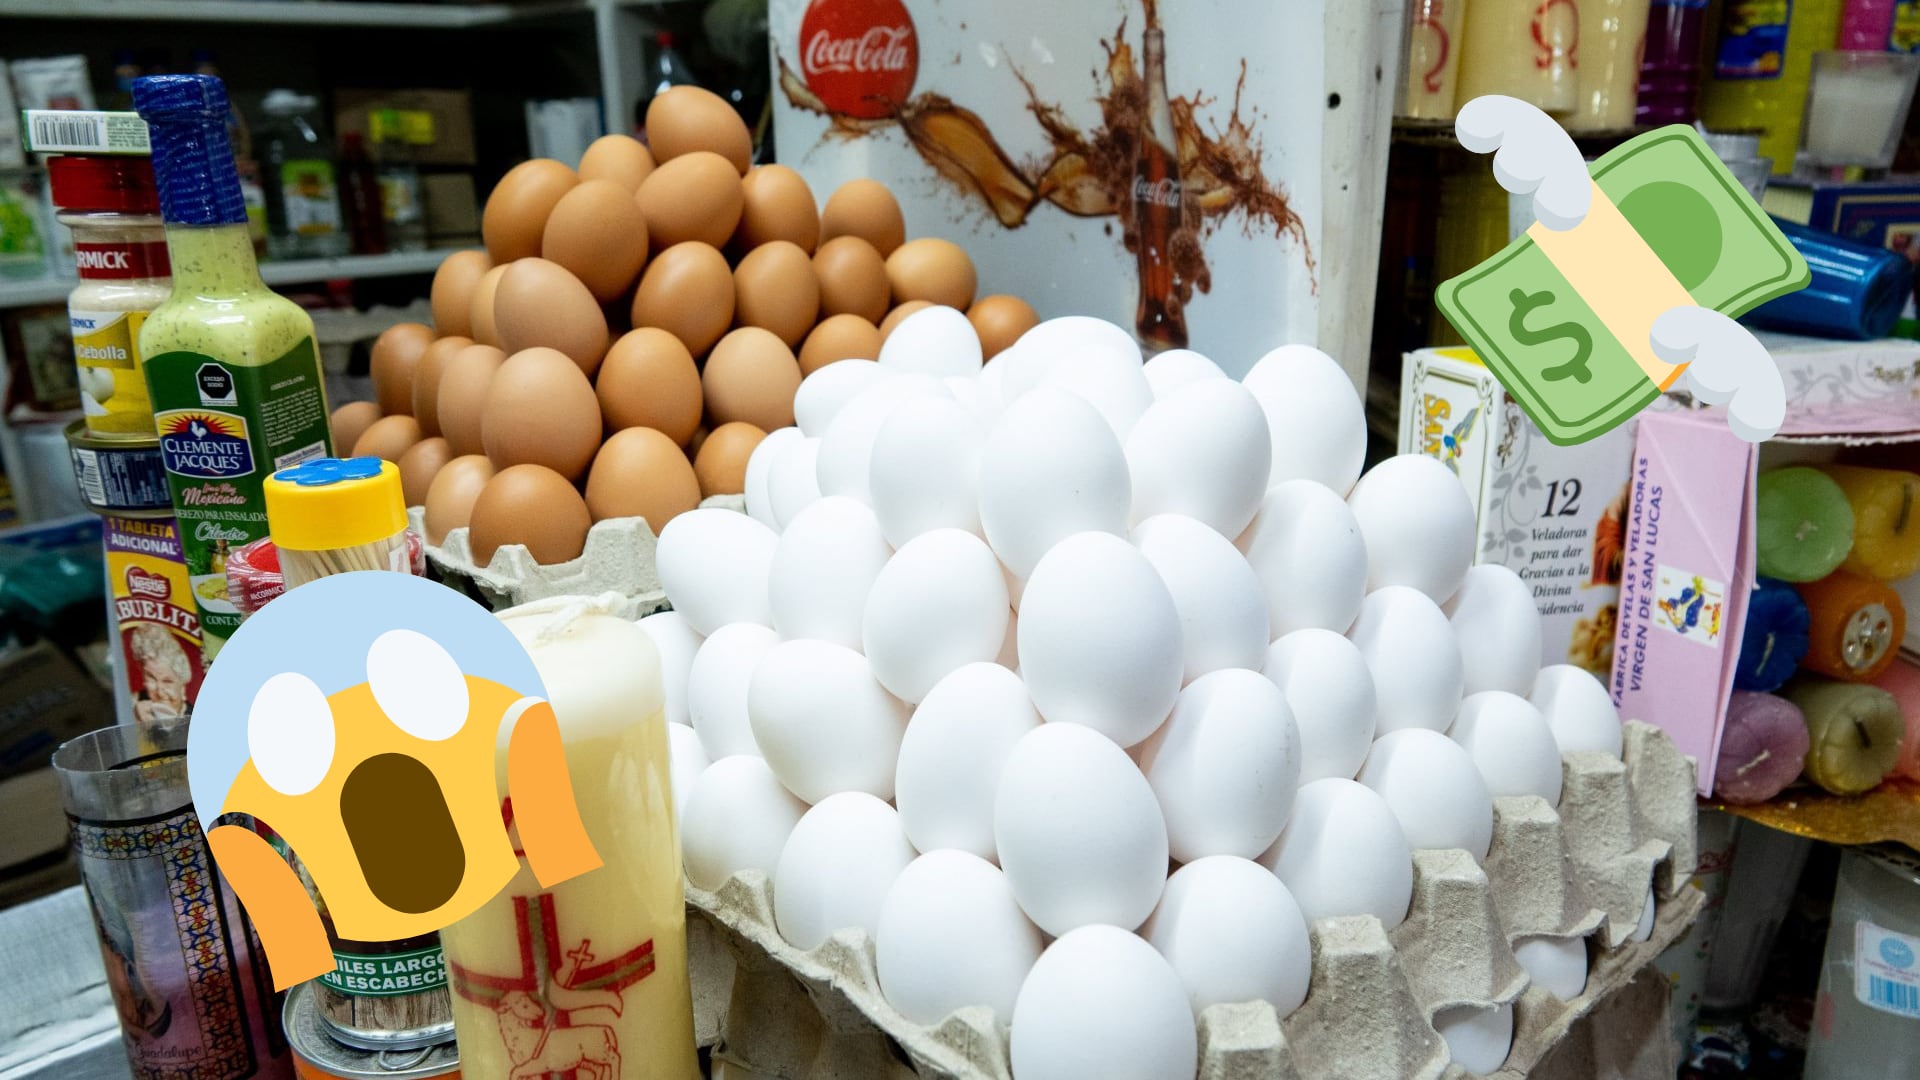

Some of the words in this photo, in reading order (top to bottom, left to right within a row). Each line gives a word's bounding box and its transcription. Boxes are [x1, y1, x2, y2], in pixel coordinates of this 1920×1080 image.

[806, 25, 912, 75] Coca-Cola
[74, 251, 129, 269] RMICK
[164, 439, 244, 455] CLEMENTE
[173, 455, 240, 474] JACQUES
[182, 487, 247, 505] Mexicana
[1541, 478, 1582, 518] 12
[1630, 458, 1648, 552] VELADORAS
[205, 510, 225, 521] PARA
[1646, 486, 1663, 545] LUCAS
[109, 518, 115, 530] 1
[119, 519, 175, 539] TABLETA
[1532, 525, 1587, 541] Veladoras
[111, 533, 177, 555] ADICIONAL
[1530, 550, 1559, 564] para
[1562, 546, 1584, 559] dar
[1629, 557, 1637, 568] Y
[1519, 566, 1564, 580] Gracias
[1567, 567, 1575, 577] a
[1578, 564, 1590, 576] la
[1642, 551, 1655, 590] SAN
[1533, 585, 1572, 598] Divina
[1639, 594, 1652, 619] DE
[116, 600, 201, 638] BUELIT
[1630, 624, 1649, 691] VIRGEN
[1613, 645, 1629, 709] FABRICA
[335, 959, 377, 975] ILES
[324, 971, 343, 986] EN
